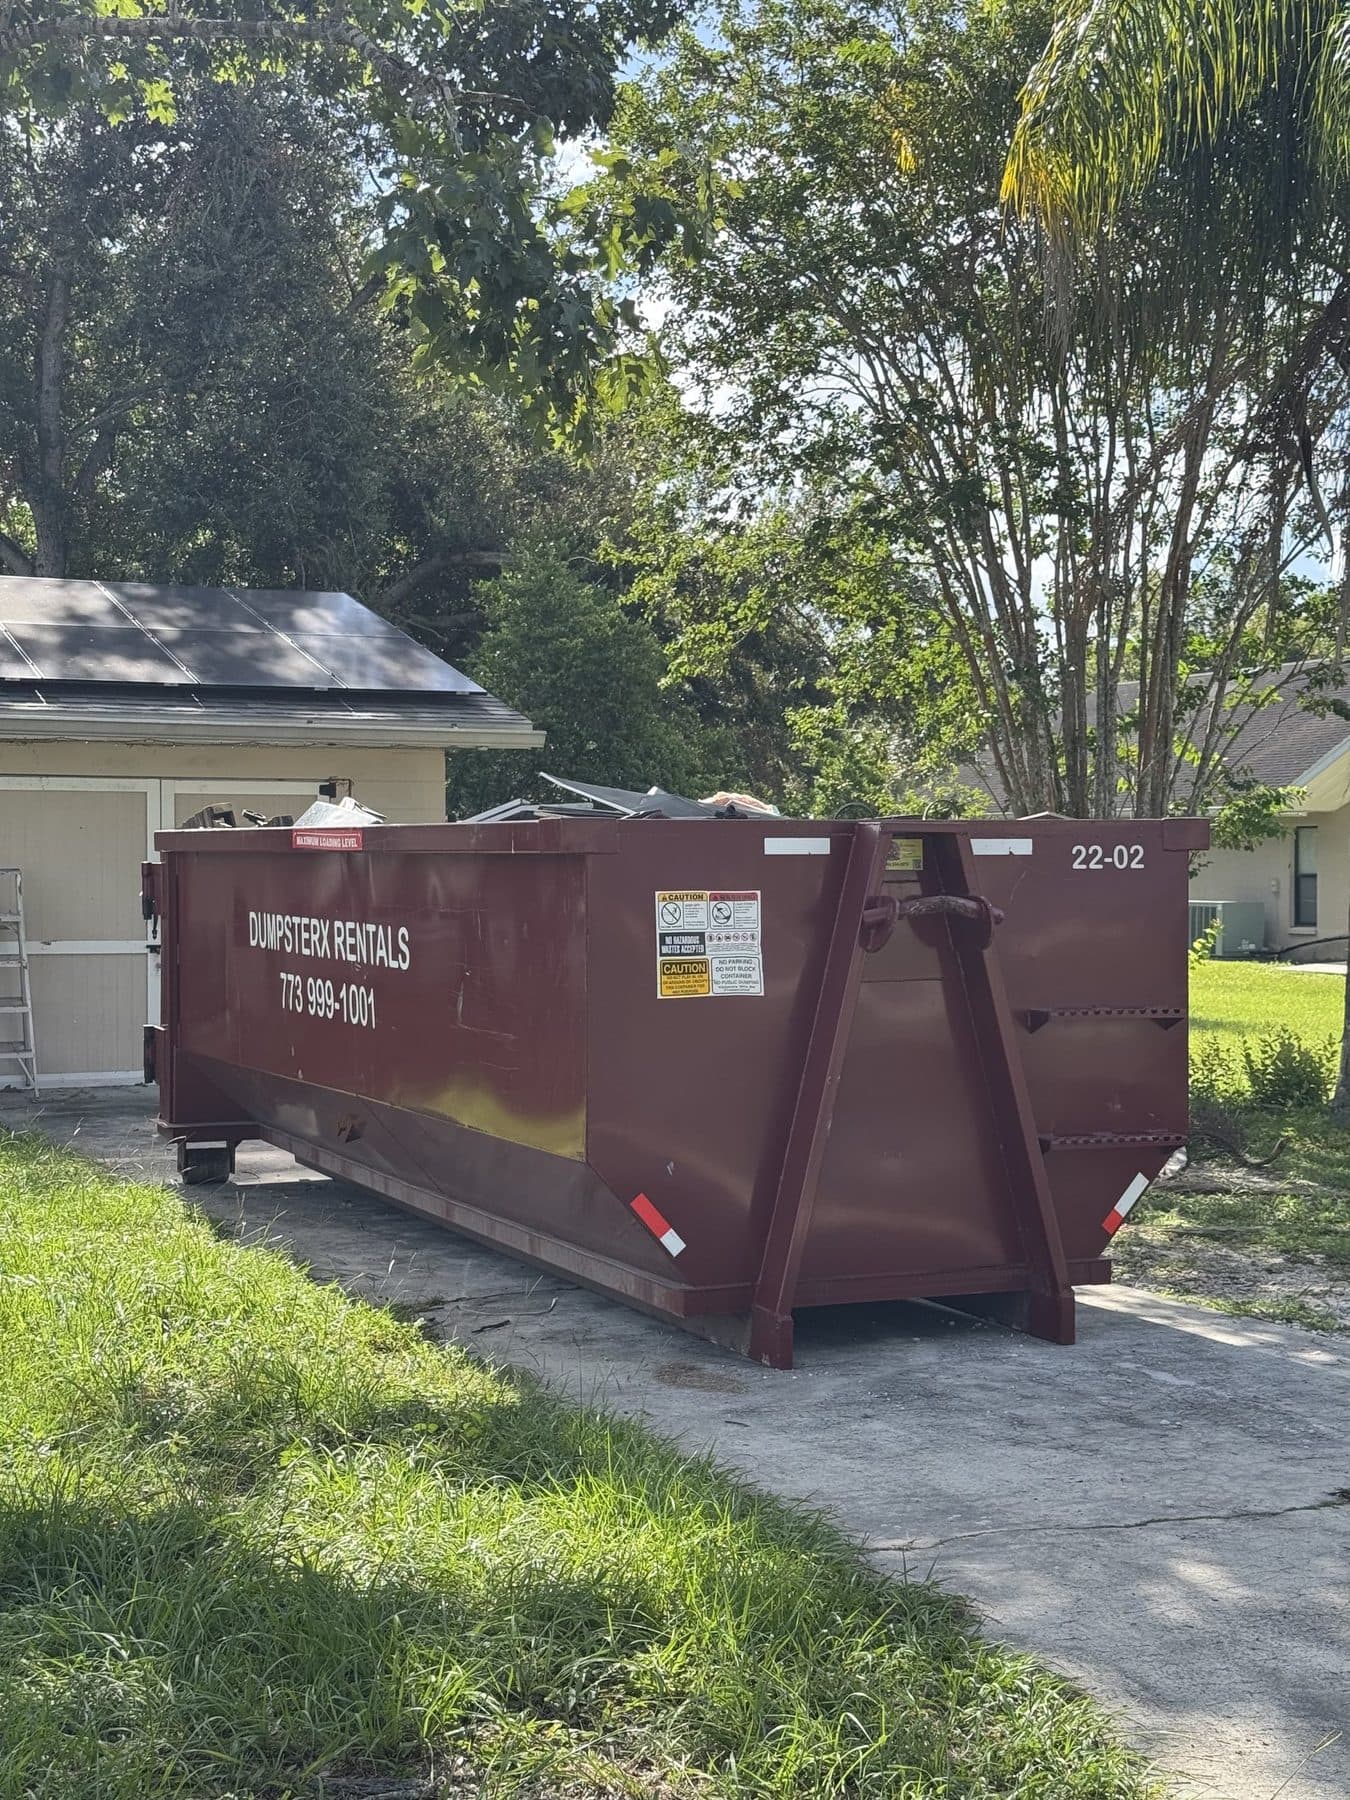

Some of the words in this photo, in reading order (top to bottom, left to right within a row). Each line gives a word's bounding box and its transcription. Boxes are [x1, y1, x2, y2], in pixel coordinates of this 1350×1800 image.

[320, 837, 341, 847] LOADING
[342, 838, 358, 848] LEVEL
[1072, 844, 1144, 869] 22-02
[249, 911, 330, 959] DUMPSTERX
[334, 920, 410, 970] RENTALS
[663, 963, 706, 974] CAUTION
[280, 972, 303, 1013] 773
[307, 977, 376, 1029] 999-1001
